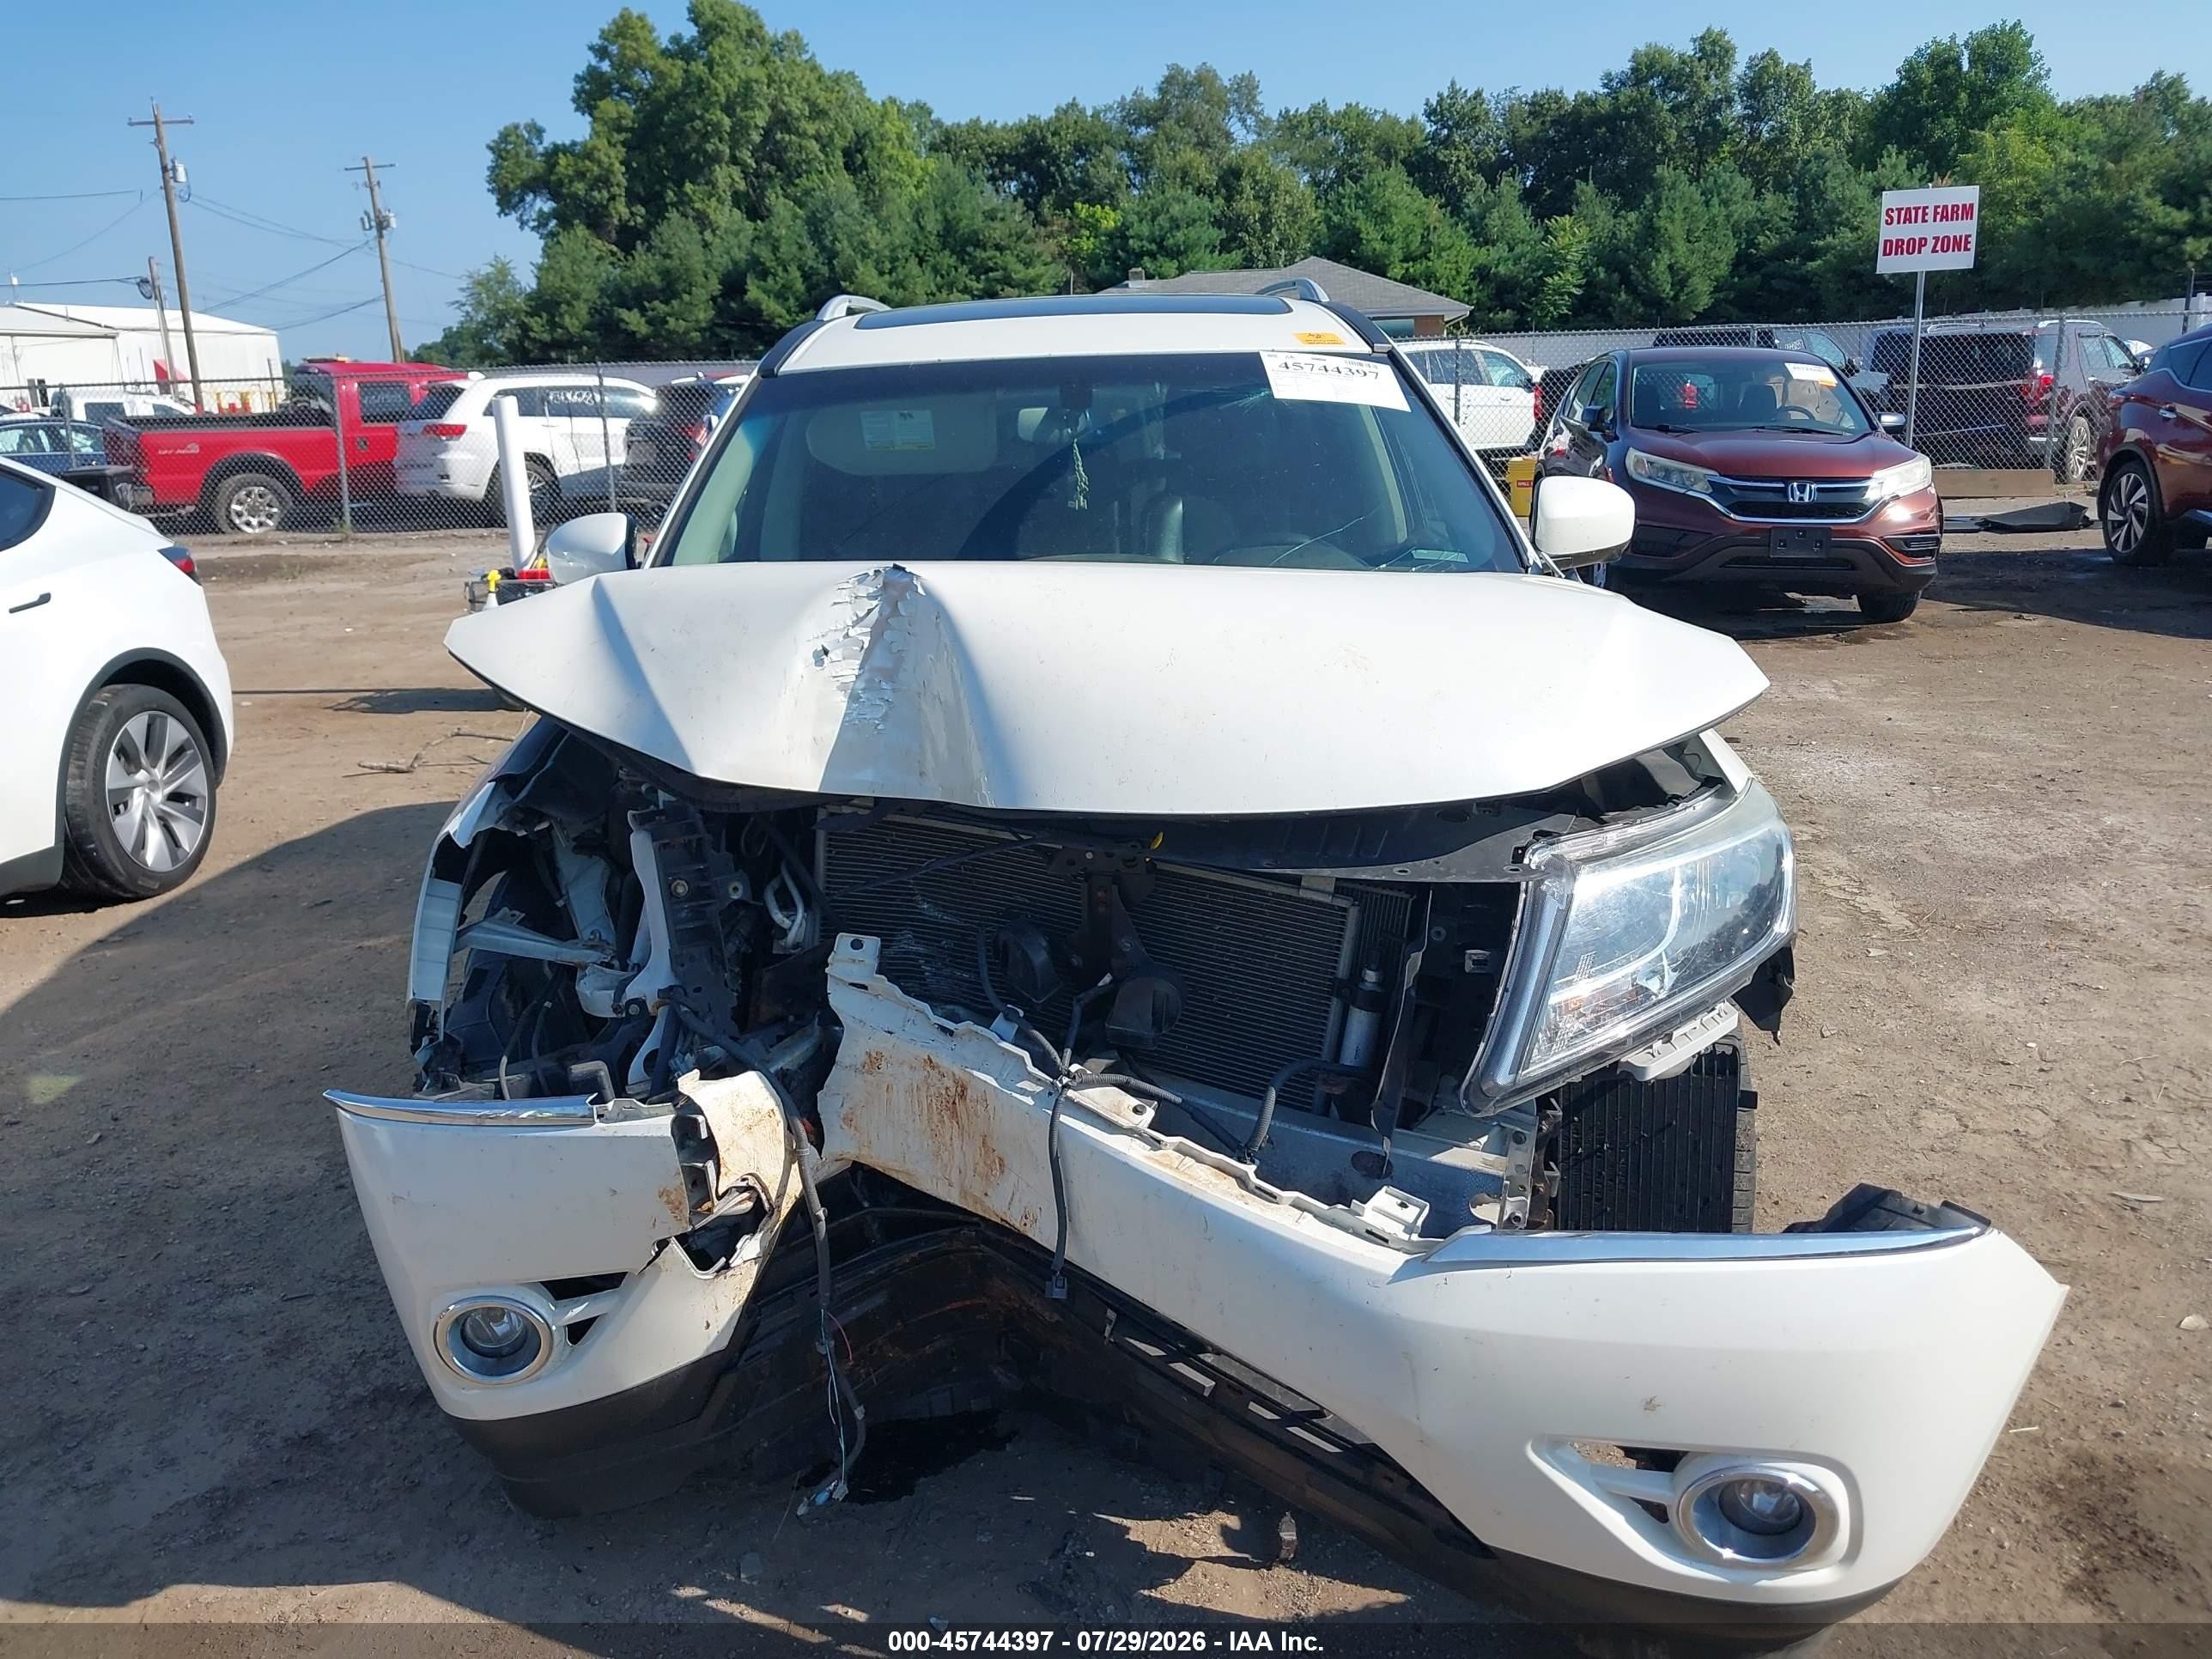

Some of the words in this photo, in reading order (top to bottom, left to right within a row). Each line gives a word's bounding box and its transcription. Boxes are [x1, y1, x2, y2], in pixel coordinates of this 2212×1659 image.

[1885, 205, 1929, 226] STATE
[1933, 203, 1974, 222] FARM
[1882, 237, 1928, 257] DROP
[1931, 234, 1972, 253] ZONE
[1279, 362, 1379, 380] 45744397
